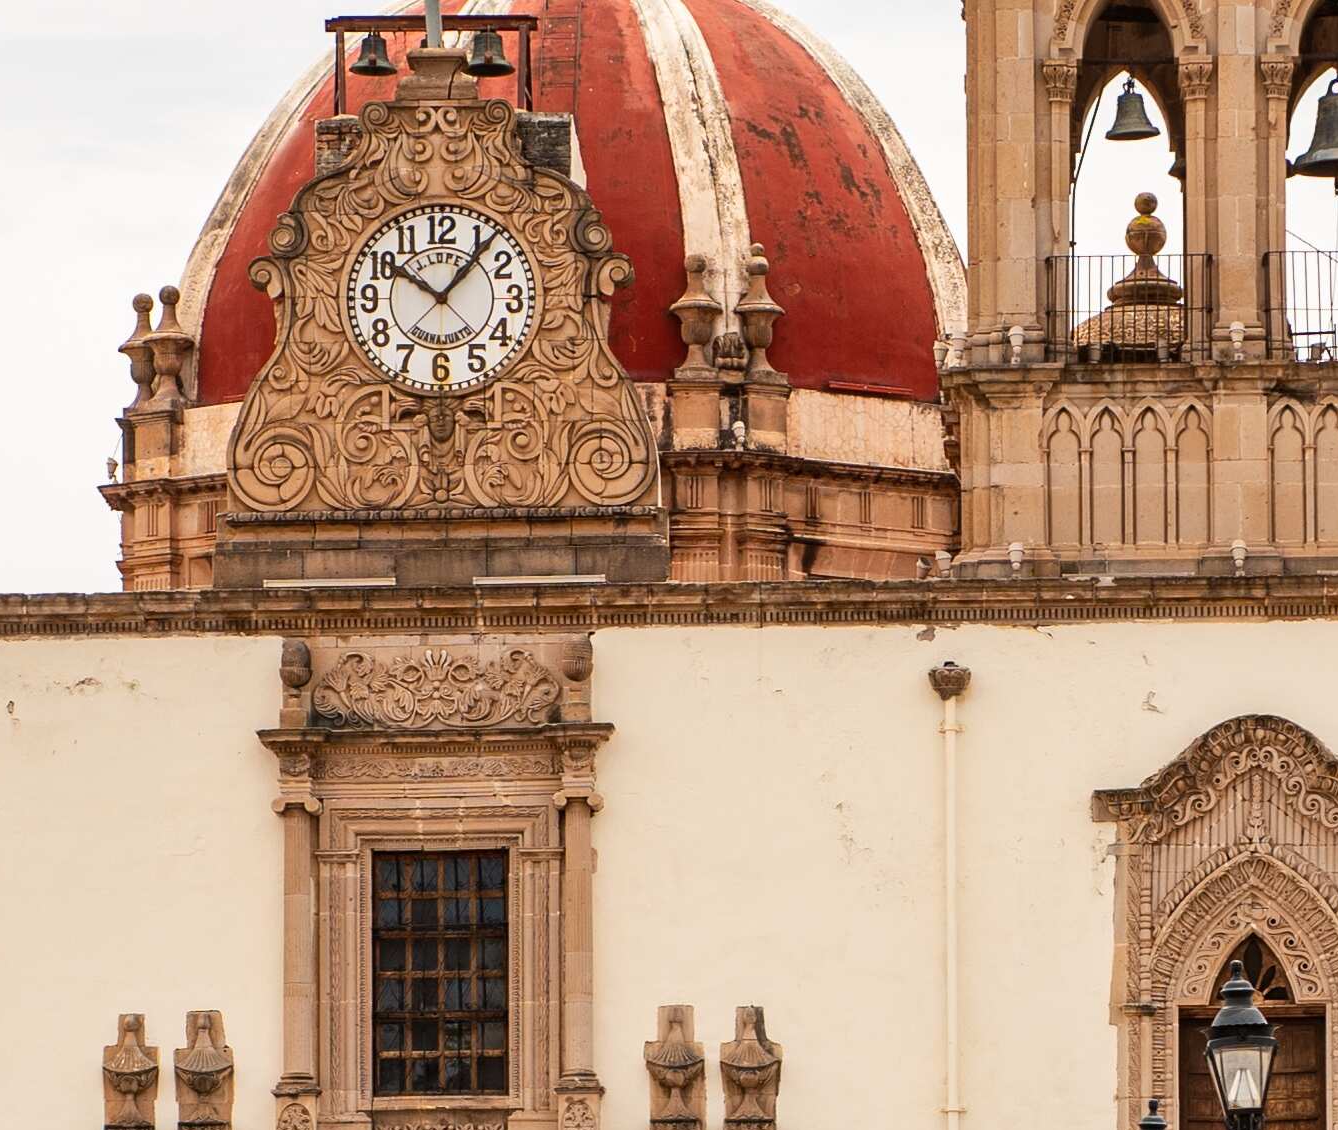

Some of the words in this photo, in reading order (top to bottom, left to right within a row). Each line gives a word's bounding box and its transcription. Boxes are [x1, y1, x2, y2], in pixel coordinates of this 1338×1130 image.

[396, 225, 415, 254] 11
[427, 215, 457, 244] 12
[472, 225, 482, 253] 1
[370, 250, 396, 280] 10
[428, 253, 470, 267] LOPE
[494, 250, 513, 279] 2
[360, 284, 379, 313] 9
[505, 284, 524, 313] 3
[372, 318, 390, 347] 8
[411, 326, 473, 345] GUANAJUATO
[489, 318, 512, 346] 4
[396, 344, 415, 373] 7
[431, 352, 450, 382] 6
[467, 344, 487, 373] 5
